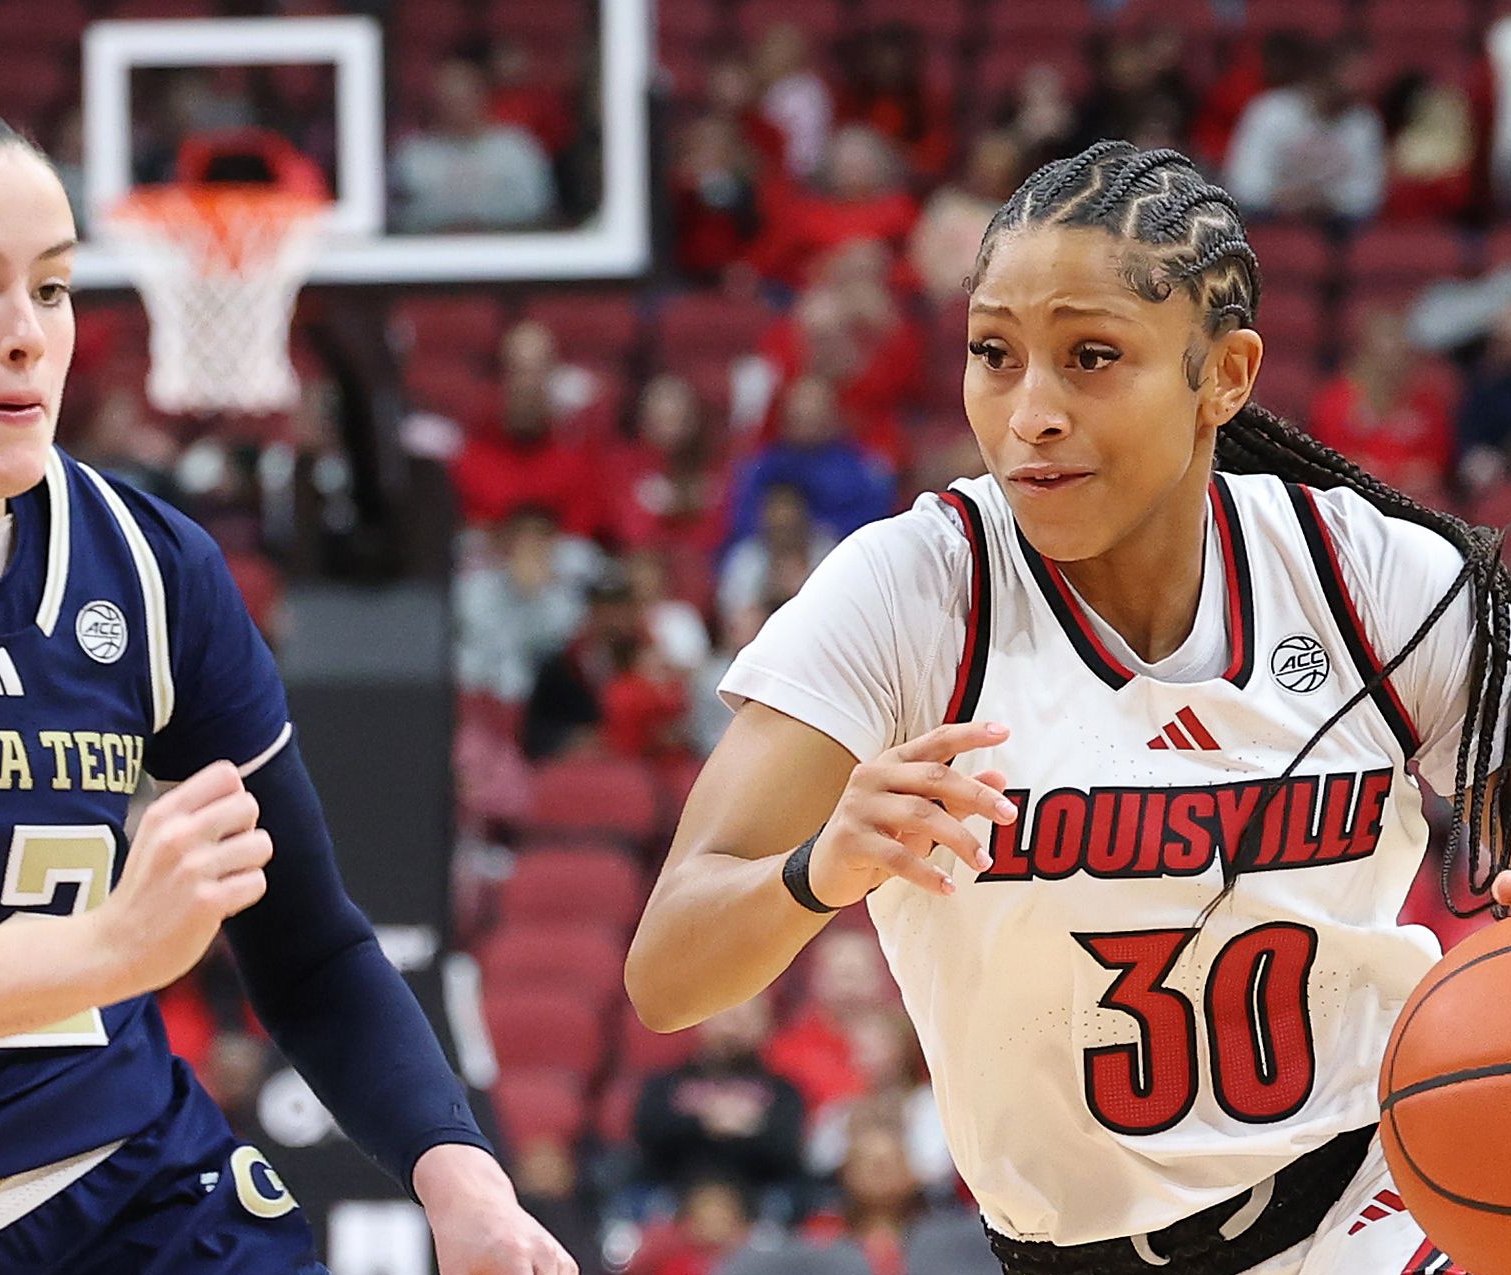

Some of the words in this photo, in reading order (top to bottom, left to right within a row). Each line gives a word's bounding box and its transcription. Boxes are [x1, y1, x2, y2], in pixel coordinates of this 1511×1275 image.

[86, 622, 121, 635] ACC
[1279, 649, 1325, 672] ACC
[39, 731, 144, 794] TECH
[975, 766, 1394, 883] LOUISVILLE
[1070, 921, 1317, 1135] 30
